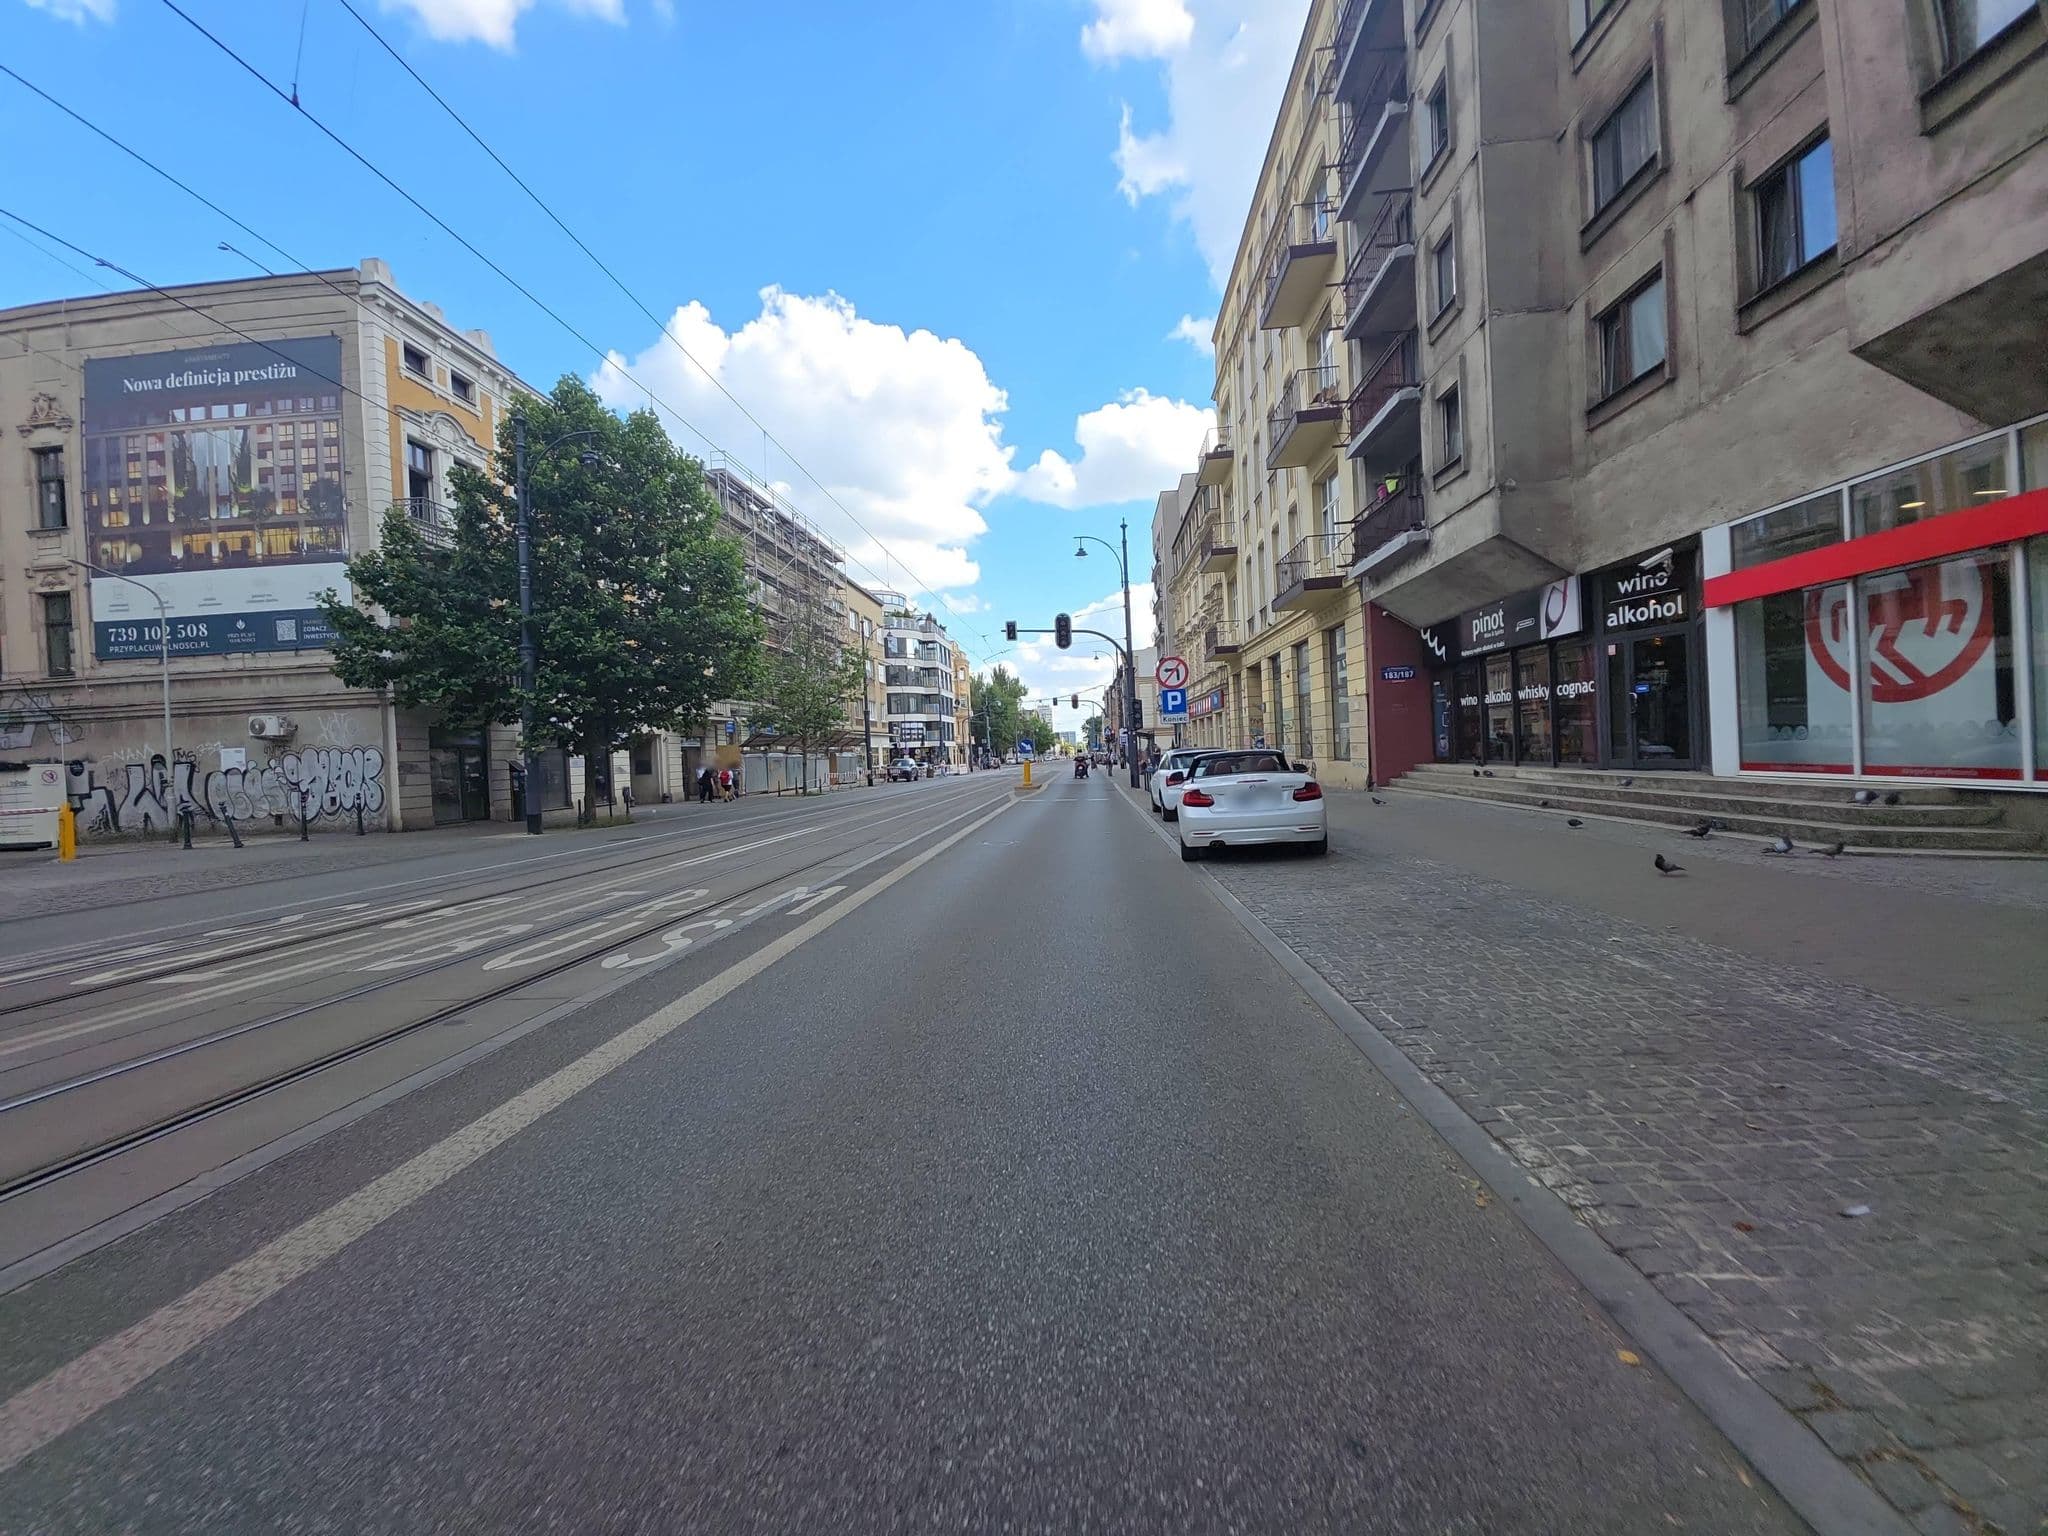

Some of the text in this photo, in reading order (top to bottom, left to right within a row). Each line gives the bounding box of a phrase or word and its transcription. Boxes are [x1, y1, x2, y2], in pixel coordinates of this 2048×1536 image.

[123, 363, 297, 393] Nowa definicja prestiżu
[1617, 571, 1669, 594] wino
[1606, 594, 1683, 627] alkohol
[107, 622, 208, 642] 739 102 508
[303, 625, 327, 633] ZOBACZ
[1472, 608, 1504, 642] pinot
[109, 641, 210, 653] PRZYPLACUWLNOSCI.PL
[1384, 670, 1414, 680] 183/187
[1518, 683, 1550, 700] whisky
[1556, 680, 1596, 698] cognac
[1167, 691, 1182, 711] P
[1460, 694, 1478, 706] wino
[537, 885, 848, 921] TRAM
[352, 918, 734, 972] BUS
